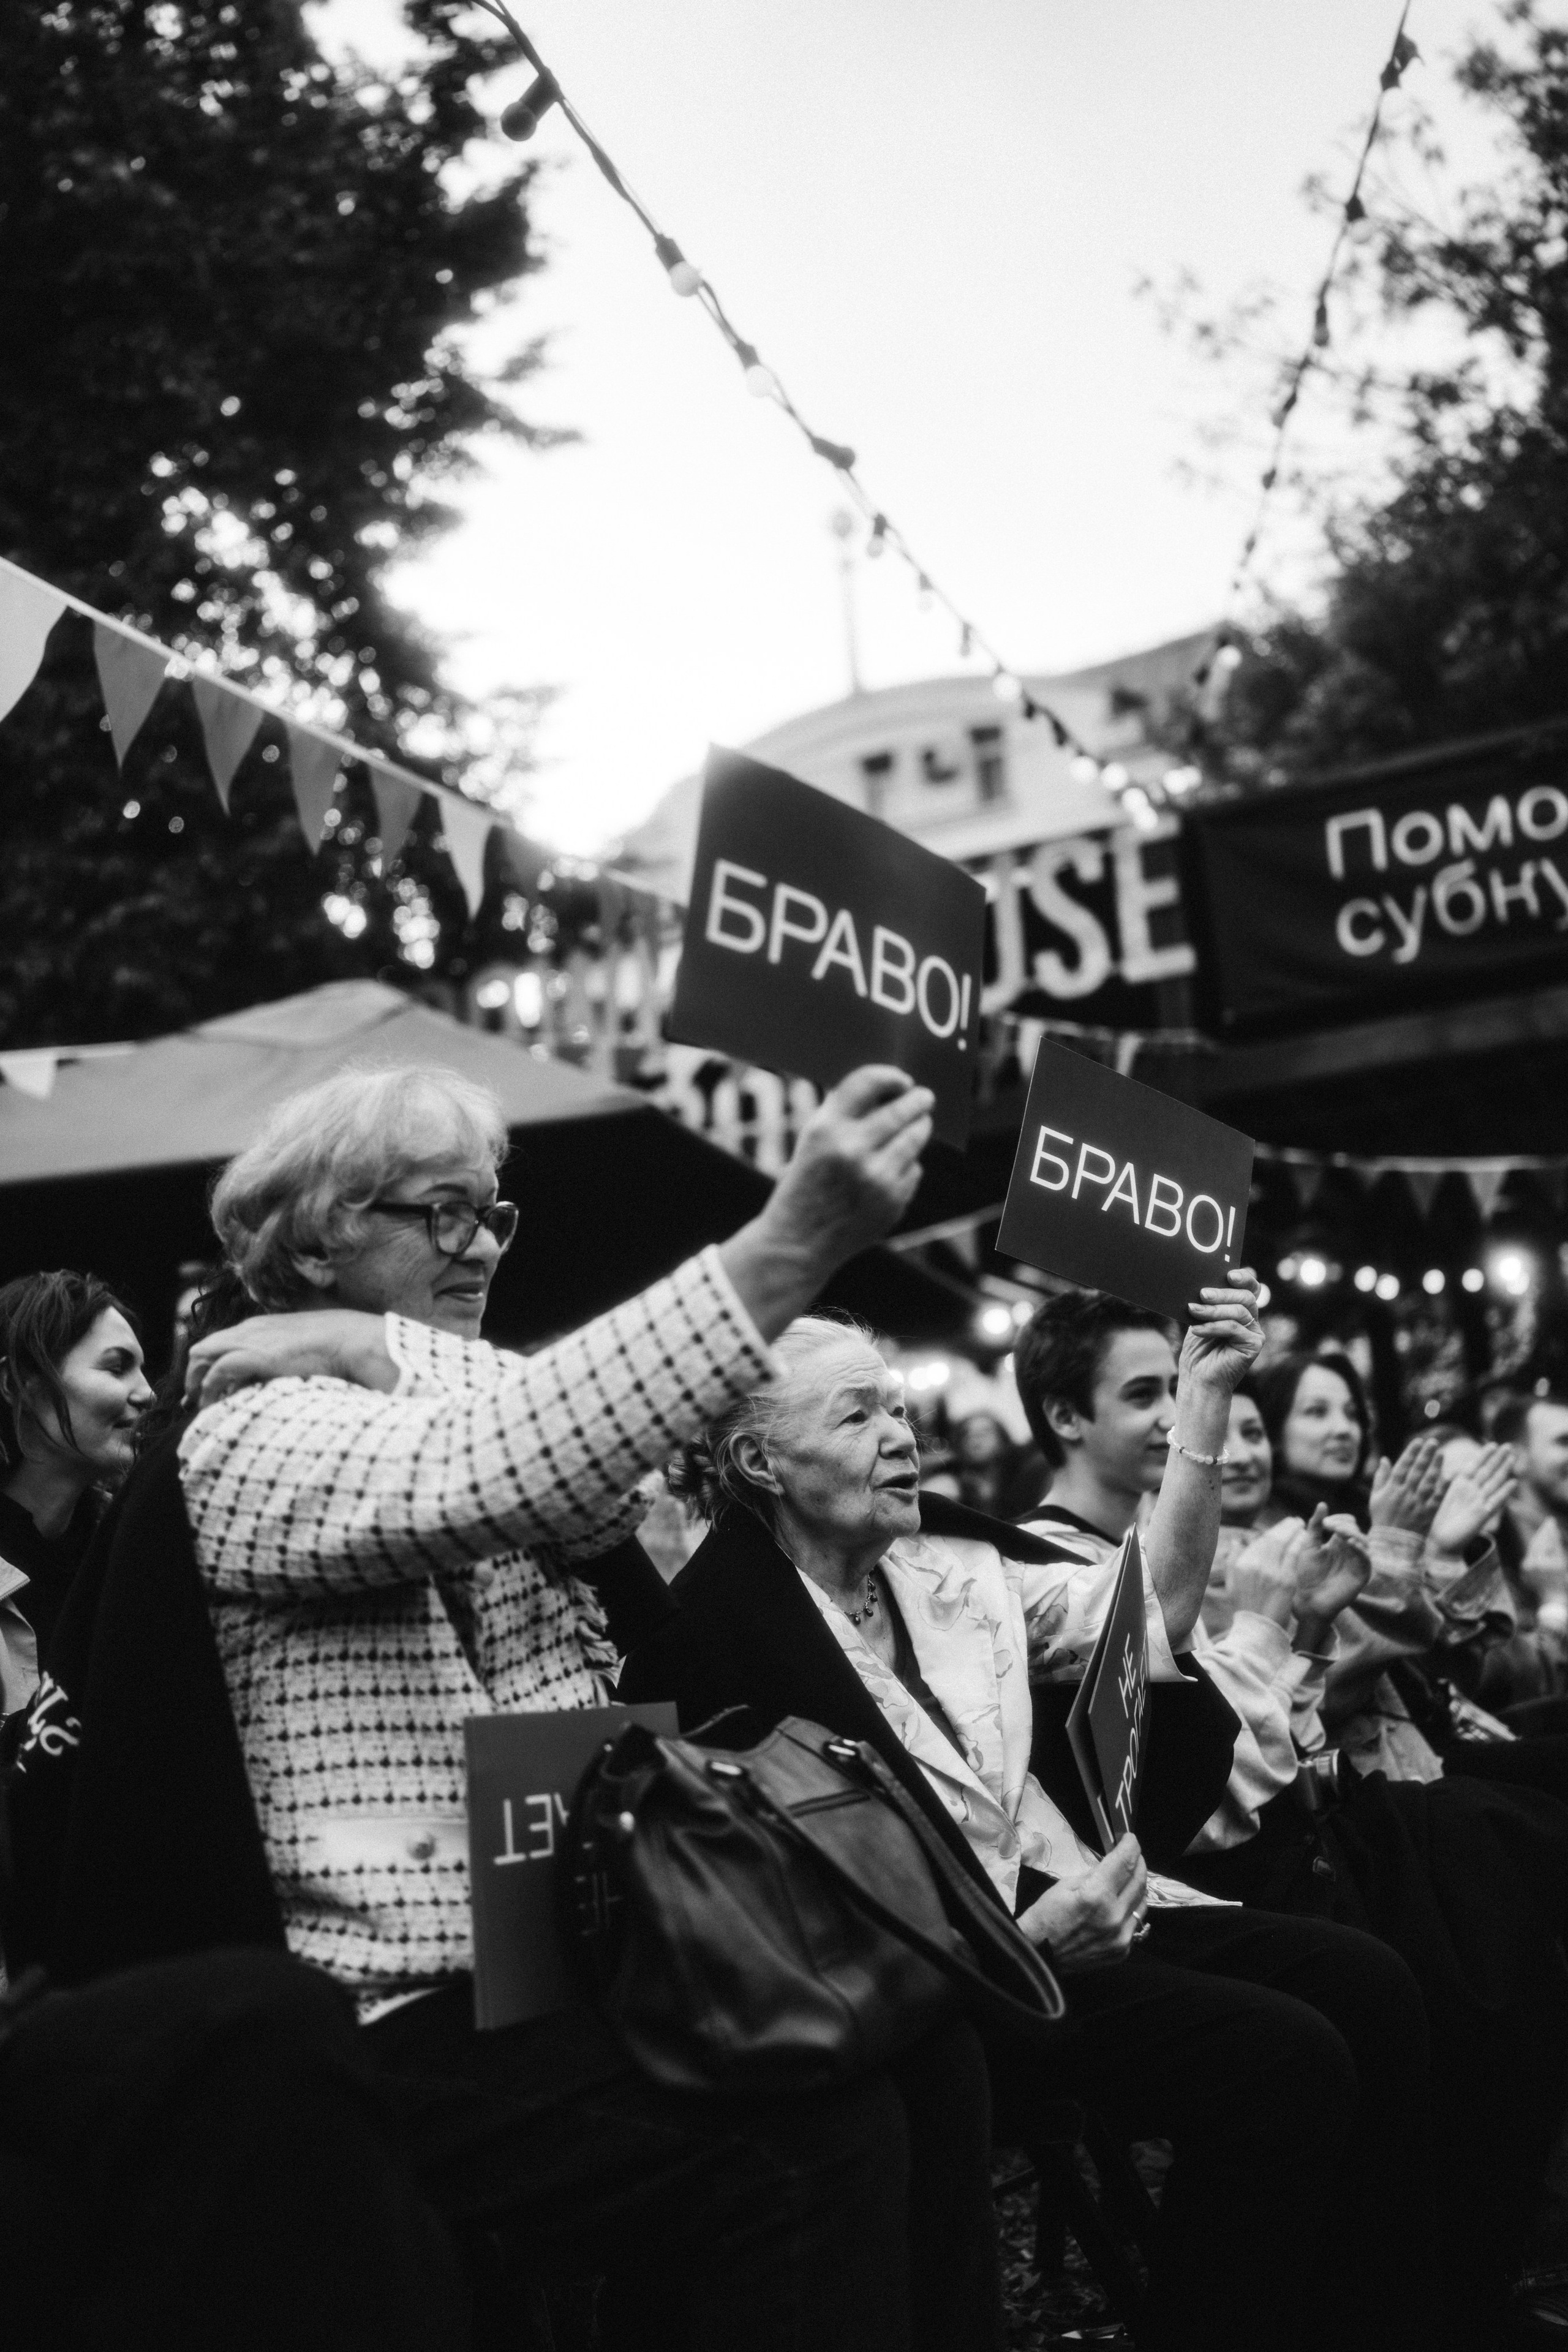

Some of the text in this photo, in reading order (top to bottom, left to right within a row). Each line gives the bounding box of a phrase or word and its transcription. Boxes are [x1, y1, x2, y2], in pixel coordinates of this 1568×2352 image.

[706, 859, 971, 1050] БРАВО!
[1030, 1126, 1235, 1262] БРАВО!
[1118, 1632, 1136, 1719] НЕ
